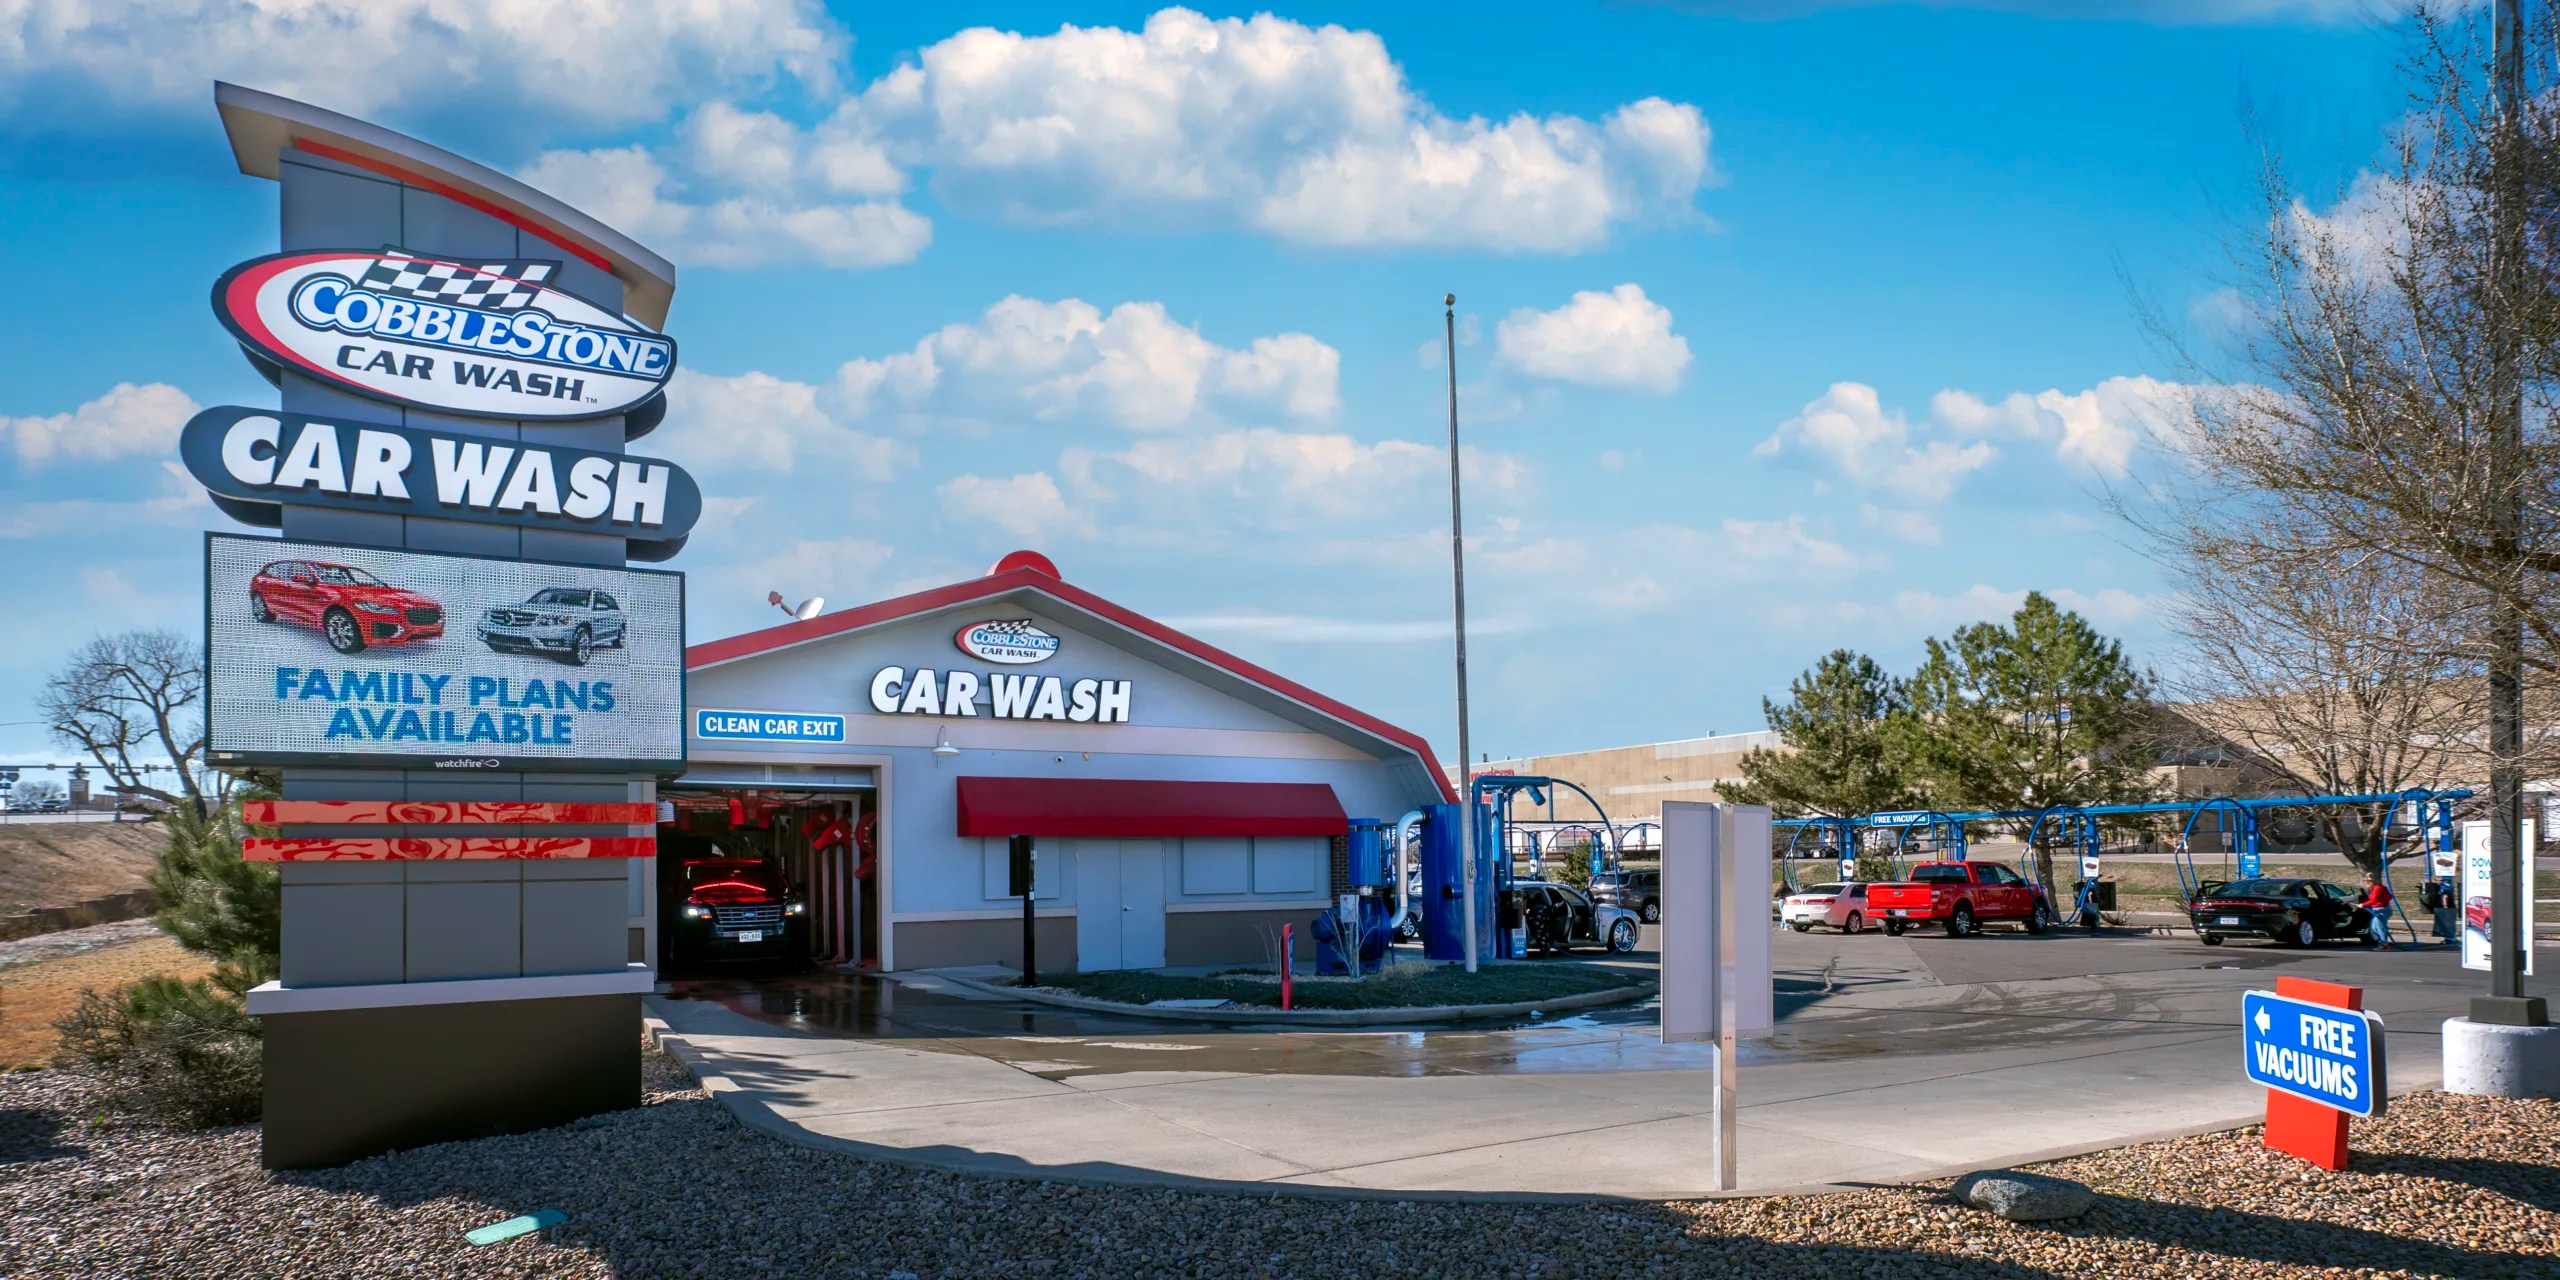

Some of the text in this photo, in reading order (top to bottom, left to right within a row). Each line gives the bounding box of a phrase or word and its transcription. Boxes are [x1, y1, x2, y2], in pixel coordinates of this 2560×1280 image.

[336, 344, 435, 380] CAR
[454, 362, 585, 401] WASH
[221, 415, 670, 525] CAR WASH
[981, 647, 1037, 658] CAR WASH
[275, 667, 615, 713] FAMILY PLANS
[870, 666, 1132, 723] CAR WASH
[324, 707, 573, 744] AVAILABLE
[705, 716, 837, 736] CLEAN CAR EXIT
[1874, 816, 1891, 824] FREE
[2300, 1013, 2357, 1059] FREE
[2255, 1041, 2358, 1101] VACUUMS
